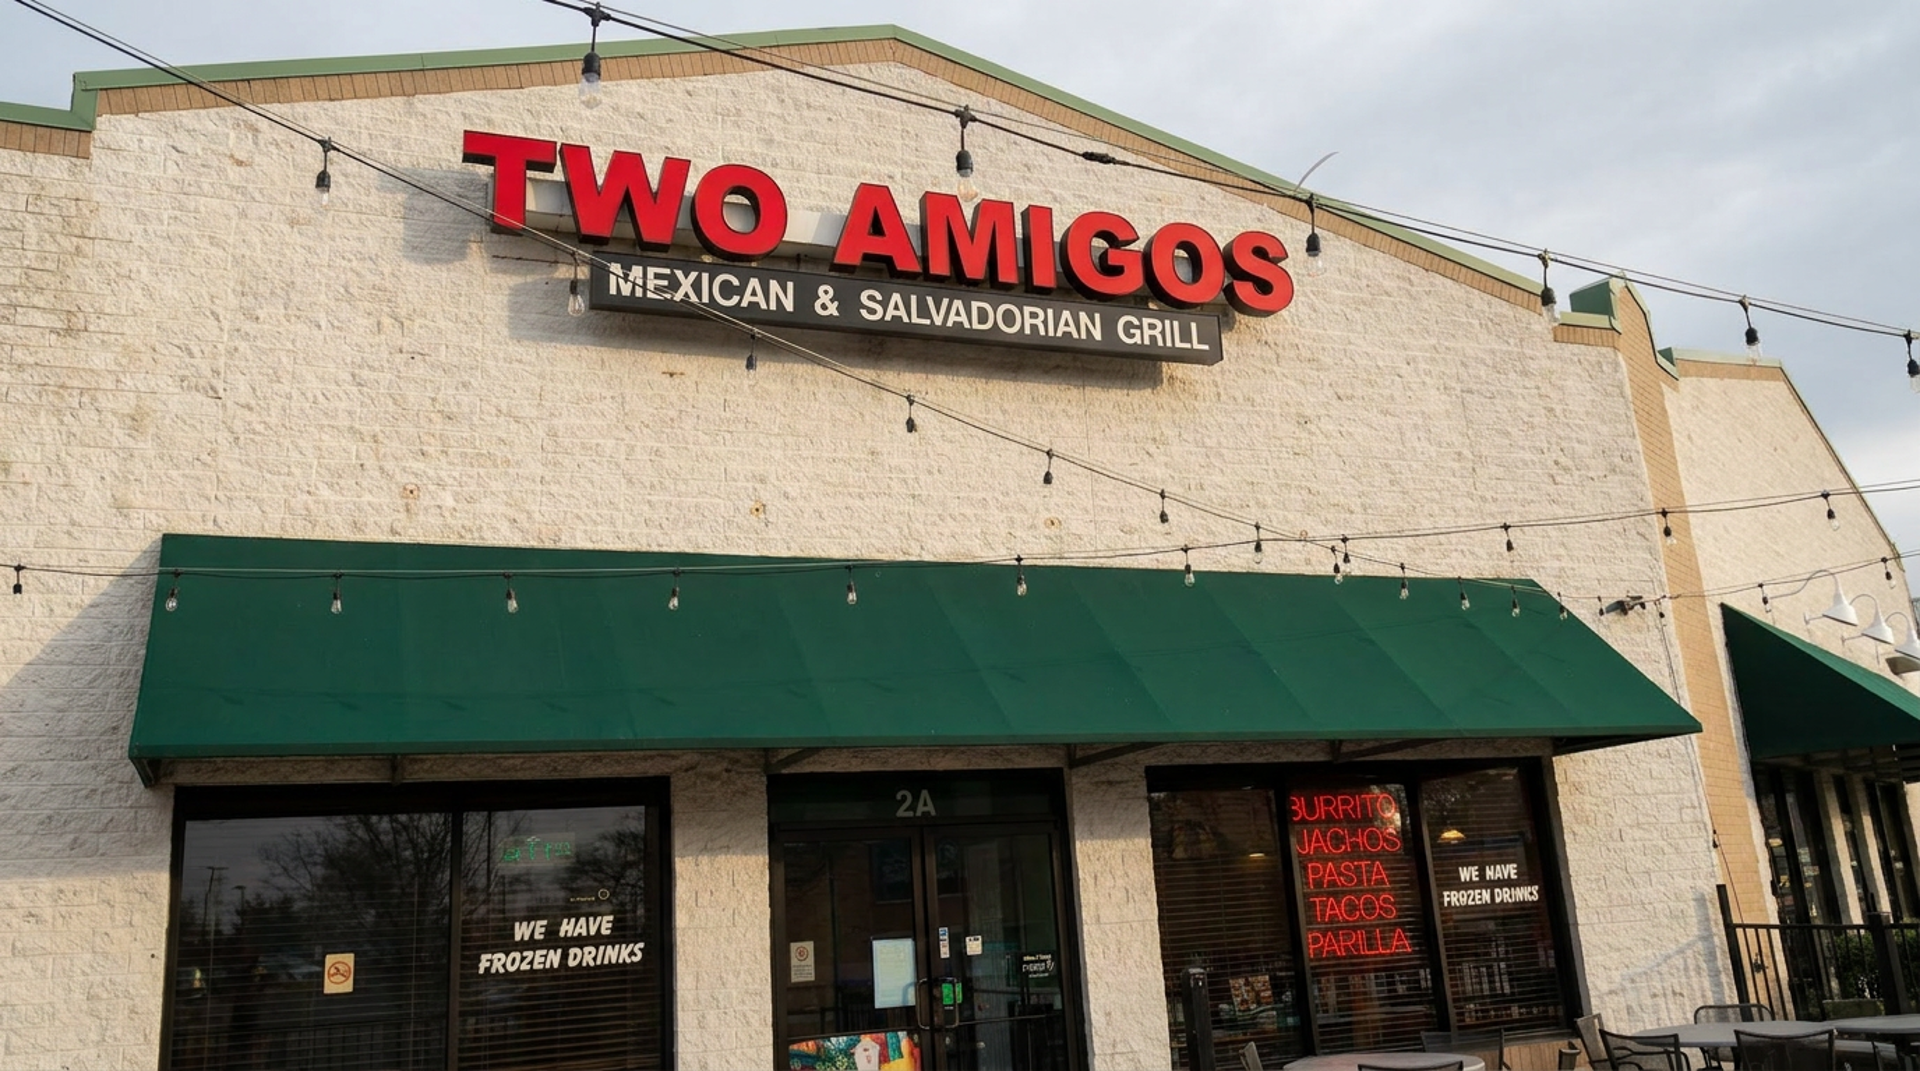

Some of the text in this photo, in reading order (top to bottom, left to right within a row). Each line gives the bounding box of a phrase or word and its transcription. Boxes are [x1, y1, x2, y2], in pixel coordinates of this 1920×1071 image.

[462, 129, 1295, 318] TWO AMIGOS
[608, 261, 1210, 351] MEXICAN & SALVADORIAN GRILL
[895, 789, 937, 818] 2A
[1307, 860, 1391, 889] PASTA
[1458, 863, 1518, 882] WE HAVE
[1309, 894, 1397, 922] TACOS
[1442, 885, 1539, 907] FROZEN DRINKS
[513, 915, 614, 942] WE HAVE
[1307, 928, 1413, 958] PARILLA
[478, 942, 645, 975] FROZEN DRINKS
